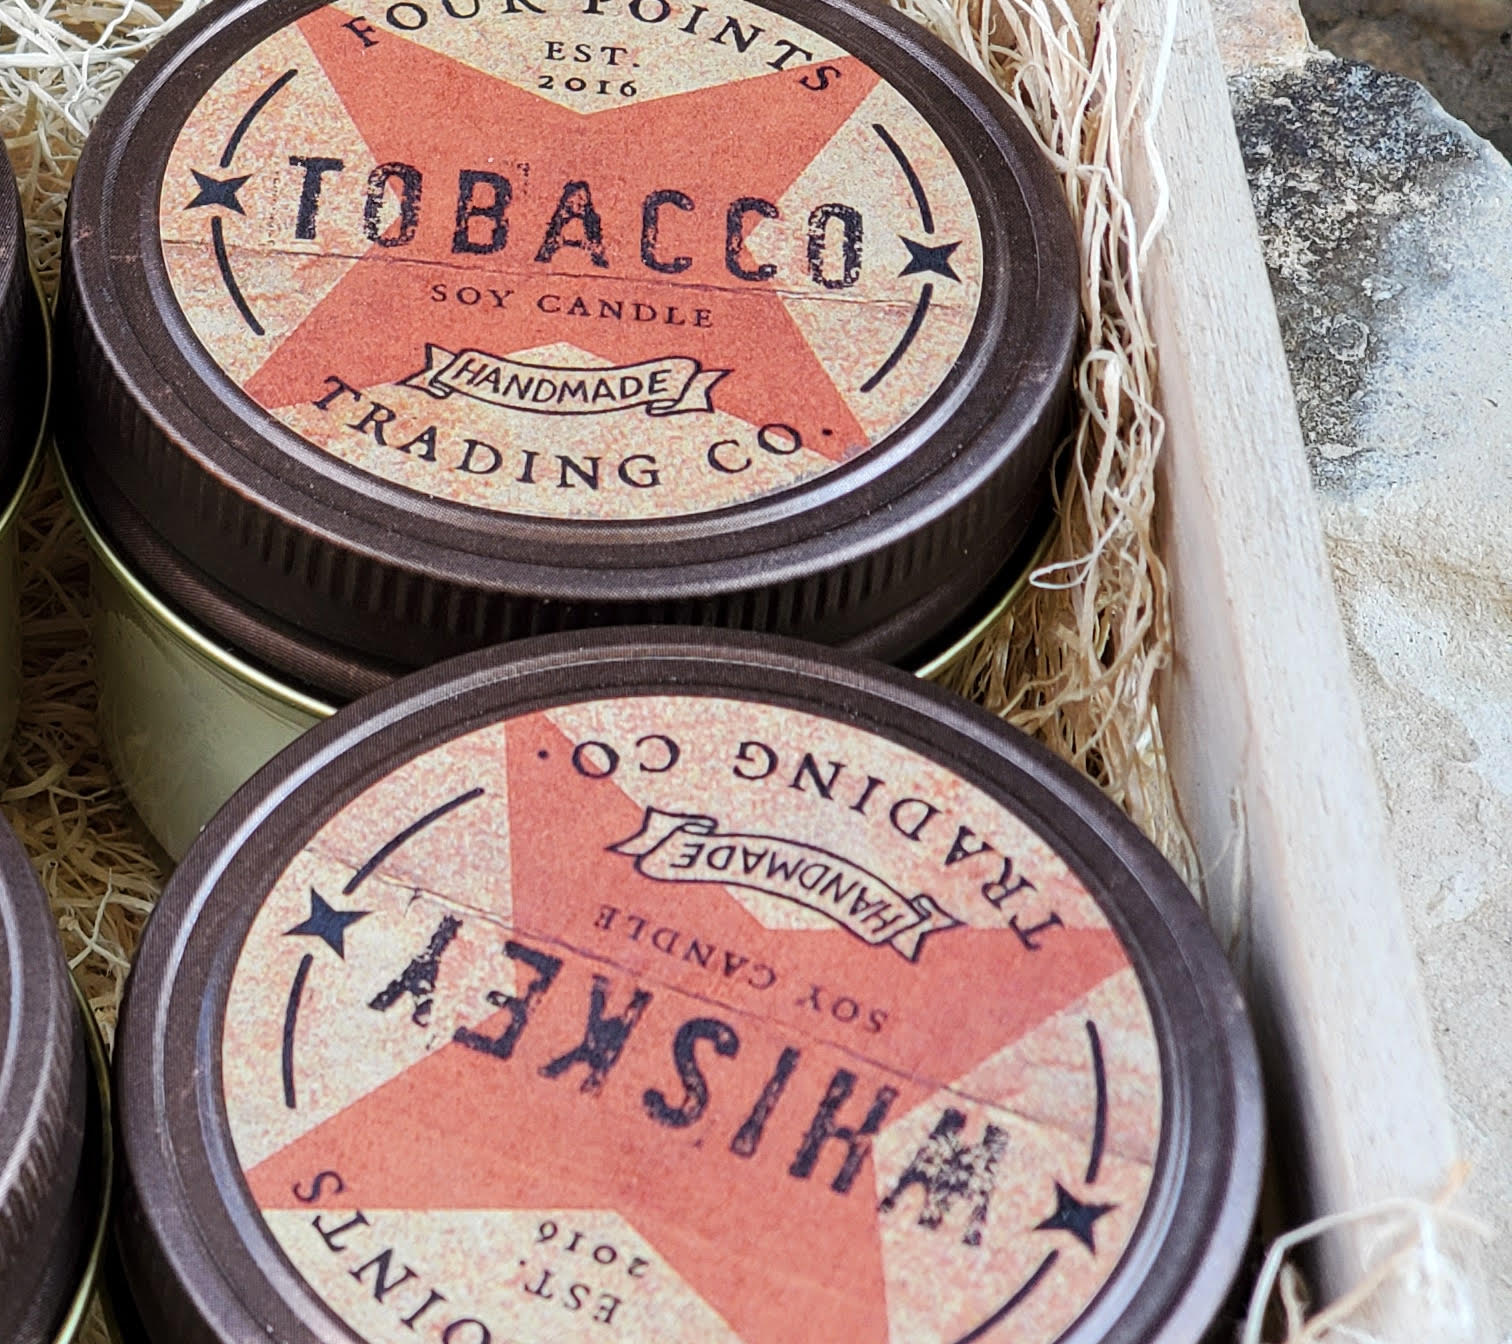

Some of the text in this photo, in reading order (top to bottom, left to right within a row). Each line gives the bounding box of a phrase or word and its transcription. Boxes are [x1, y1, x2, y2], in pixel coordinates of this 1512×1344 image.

[537, 72, 639, 98] 2016
[544, 39, 639, 68] EST.
[288, 156, 864, 290] TOBACCO
[430, 283, 714, 330] SOY CANDLE
[453, 361, 670, 405] HANDMADE
[312, 377, 659, 490] TRADING
[733, 739, 1068, 951] TRADING
[669, 842, 901, 935] HANDMADE
[595, 903, 888, 1034] SOY CANDLE
[368, 912, 1011, 1248] WHISKEY
[514, 1256, 621, 1325] EST.
[536, 1222, 651, 1278] 2016
